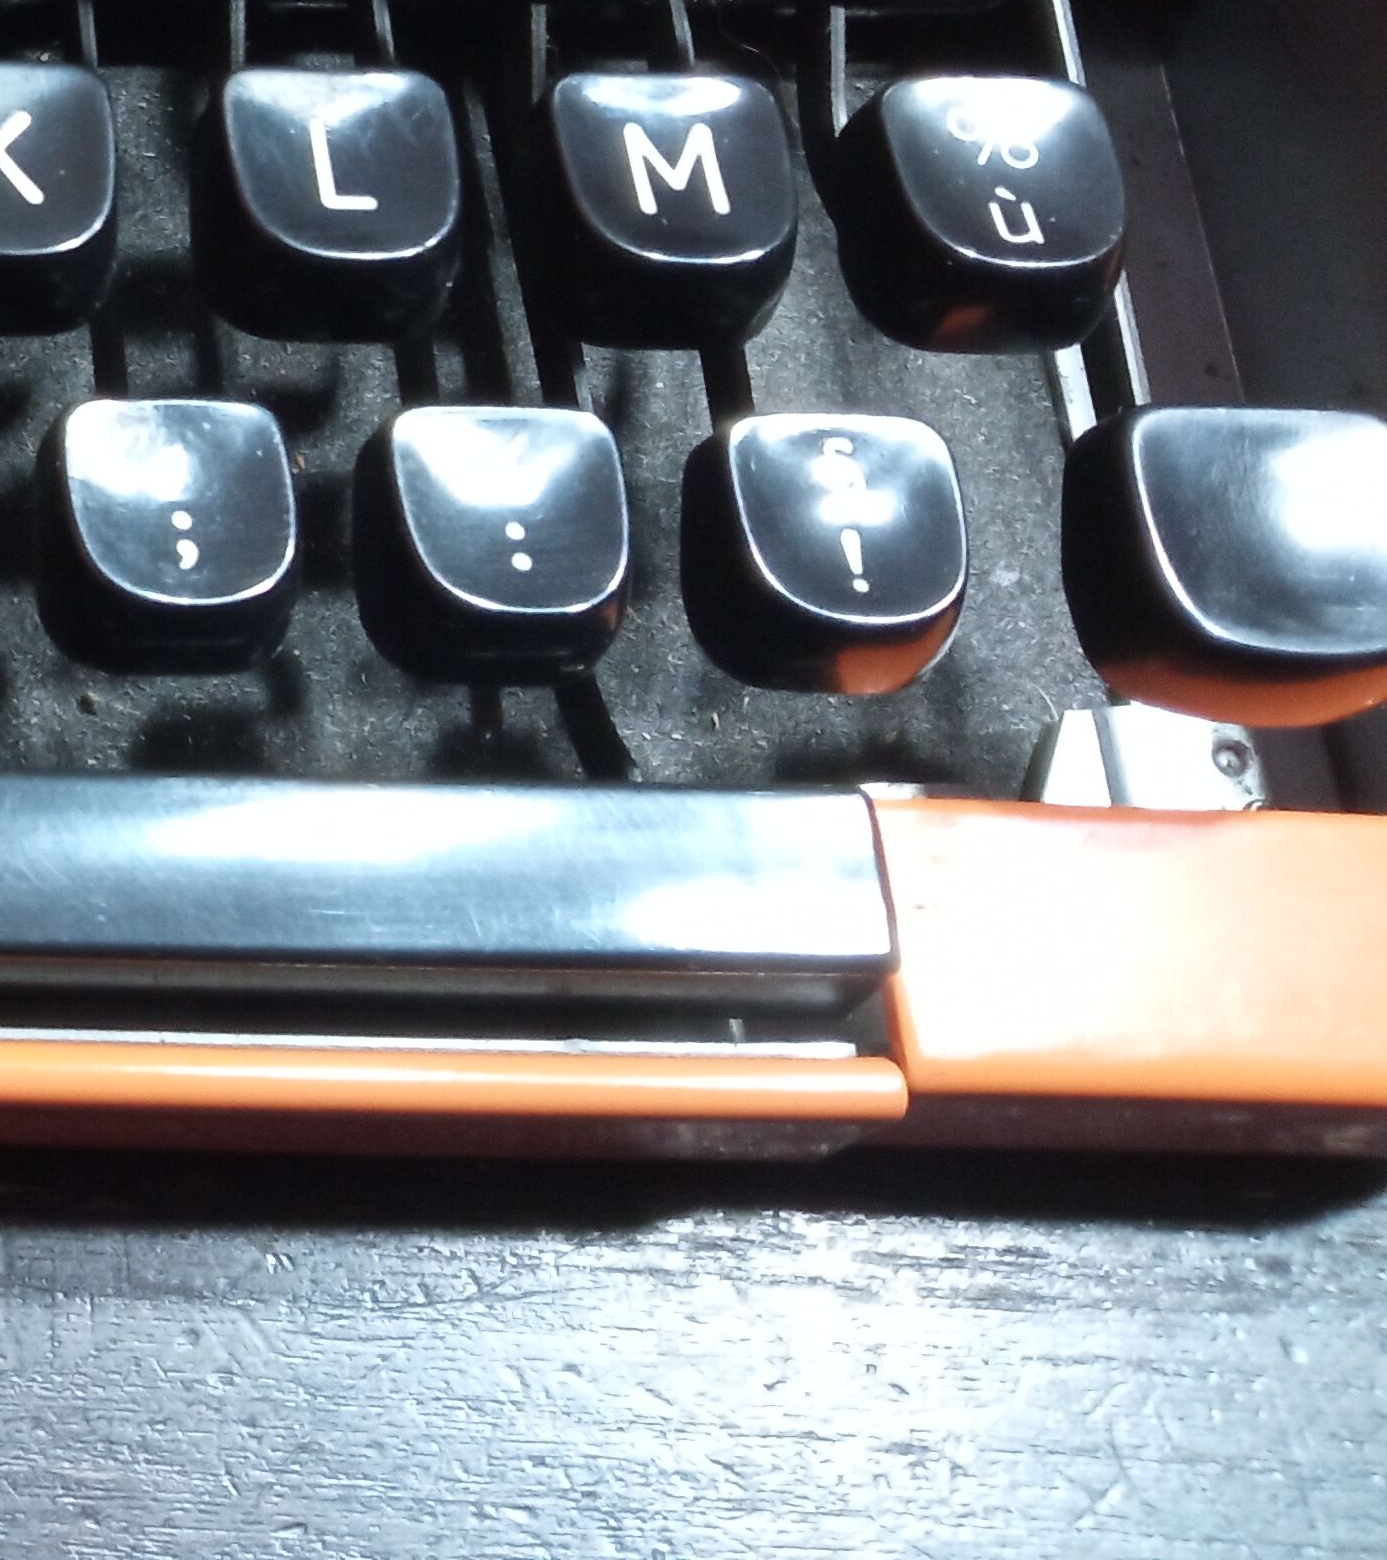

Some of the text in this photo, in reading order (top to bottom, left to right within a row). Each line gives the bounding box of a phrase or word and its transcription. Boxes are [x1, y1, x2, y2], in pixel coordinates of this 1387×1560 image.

[309, 118, 379, 212] L
[623, 121, 731, 216] M
[987, 185, 1046, 245] ù
[169, 509, 200, 571] ;
[503, 520, 534, 572] :
[838, 526, 871, 594] !
